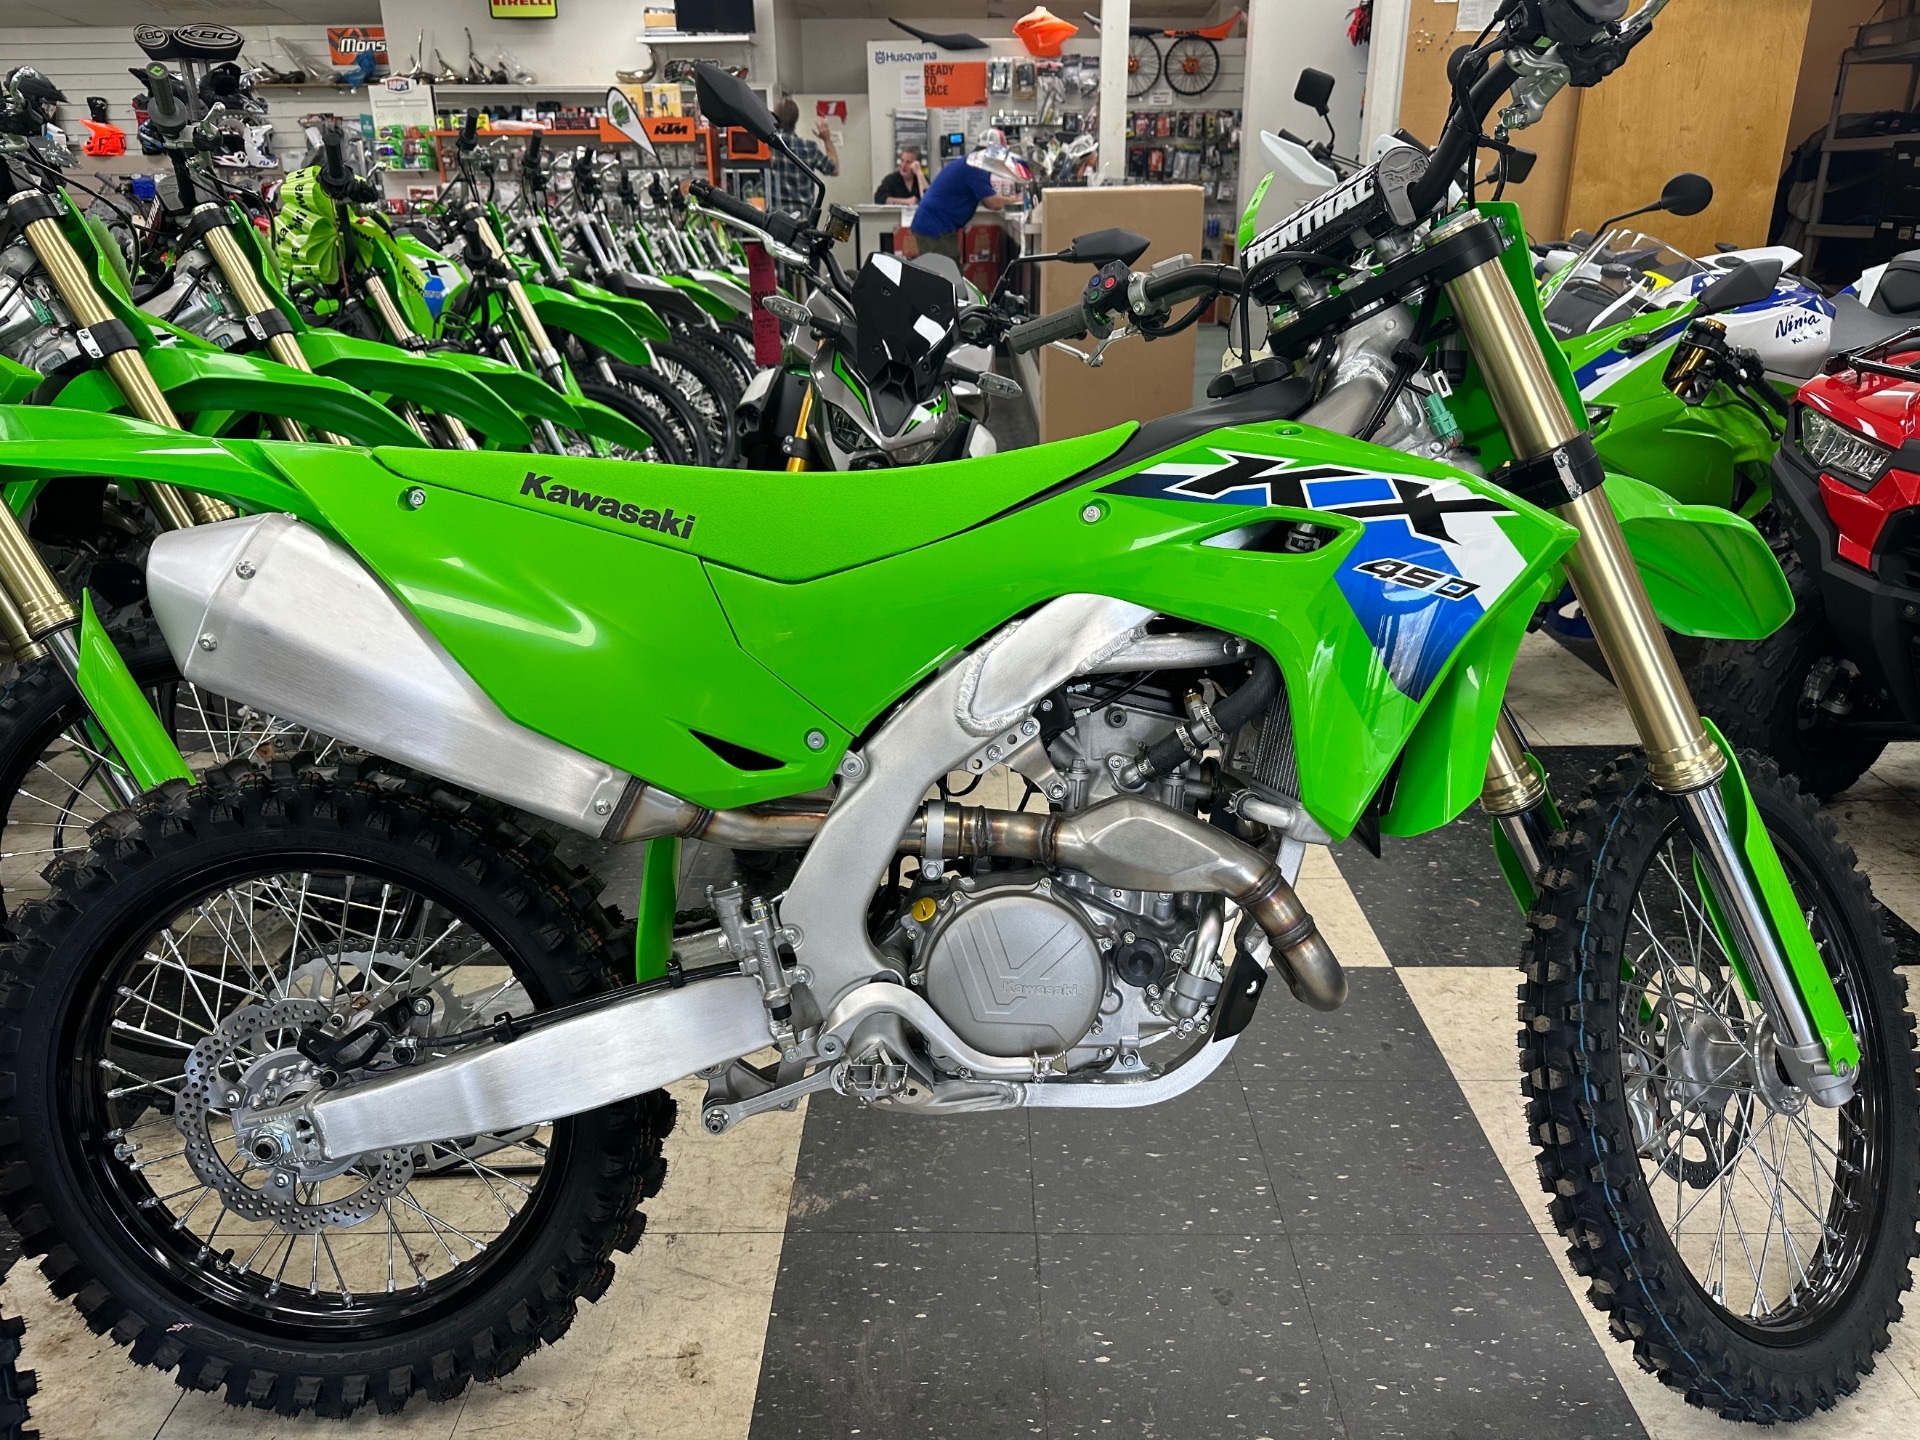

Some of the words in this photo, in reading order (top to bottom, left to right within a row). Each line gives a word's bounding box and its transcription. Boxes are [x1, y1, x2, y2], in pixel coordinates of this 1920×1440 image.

[138, 30, 164, 41] KBC
[180, 29, 237, 41] KBC
[886, 51, 937, 62] Husqvarna
[924, 64, 955, 76] READY
[924, 75, 937, 86] TO
[924, 85, 949, 96] RACE
[654, 123, 689, 135] KTM
[1246, 175, 1375, 270] RENTHAL
[1775, 310, 1821, 339] Ninja
[1165, 450, 1518, 546] KX
[519, 471, 697, 540] Kawasaki
[1352, 557, 1481, 601] 450
[1002, 980, 1079, 997] Kawasaki
